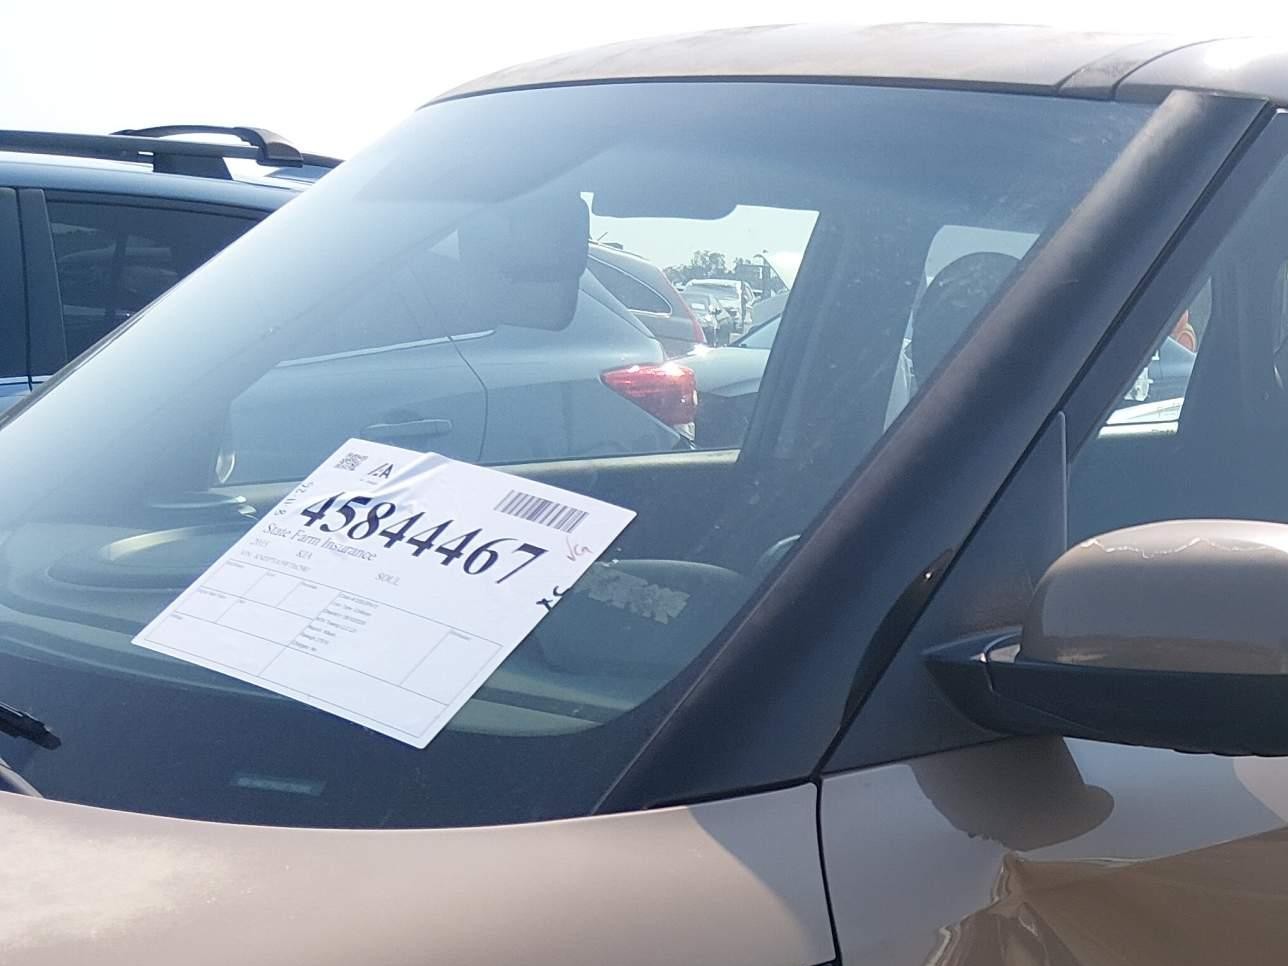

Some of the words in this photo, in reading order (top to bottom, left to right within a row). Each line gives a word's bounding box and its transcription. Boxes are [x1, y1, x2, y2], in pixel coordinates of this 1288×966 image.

[262, 521, 292, 539] State
[291, 529, 321, 547] Farm
[320, 537, 377, 561] Insurance
[299, 491, 549, 584] 45844467
[375, 572, 401, 586] SOUL
